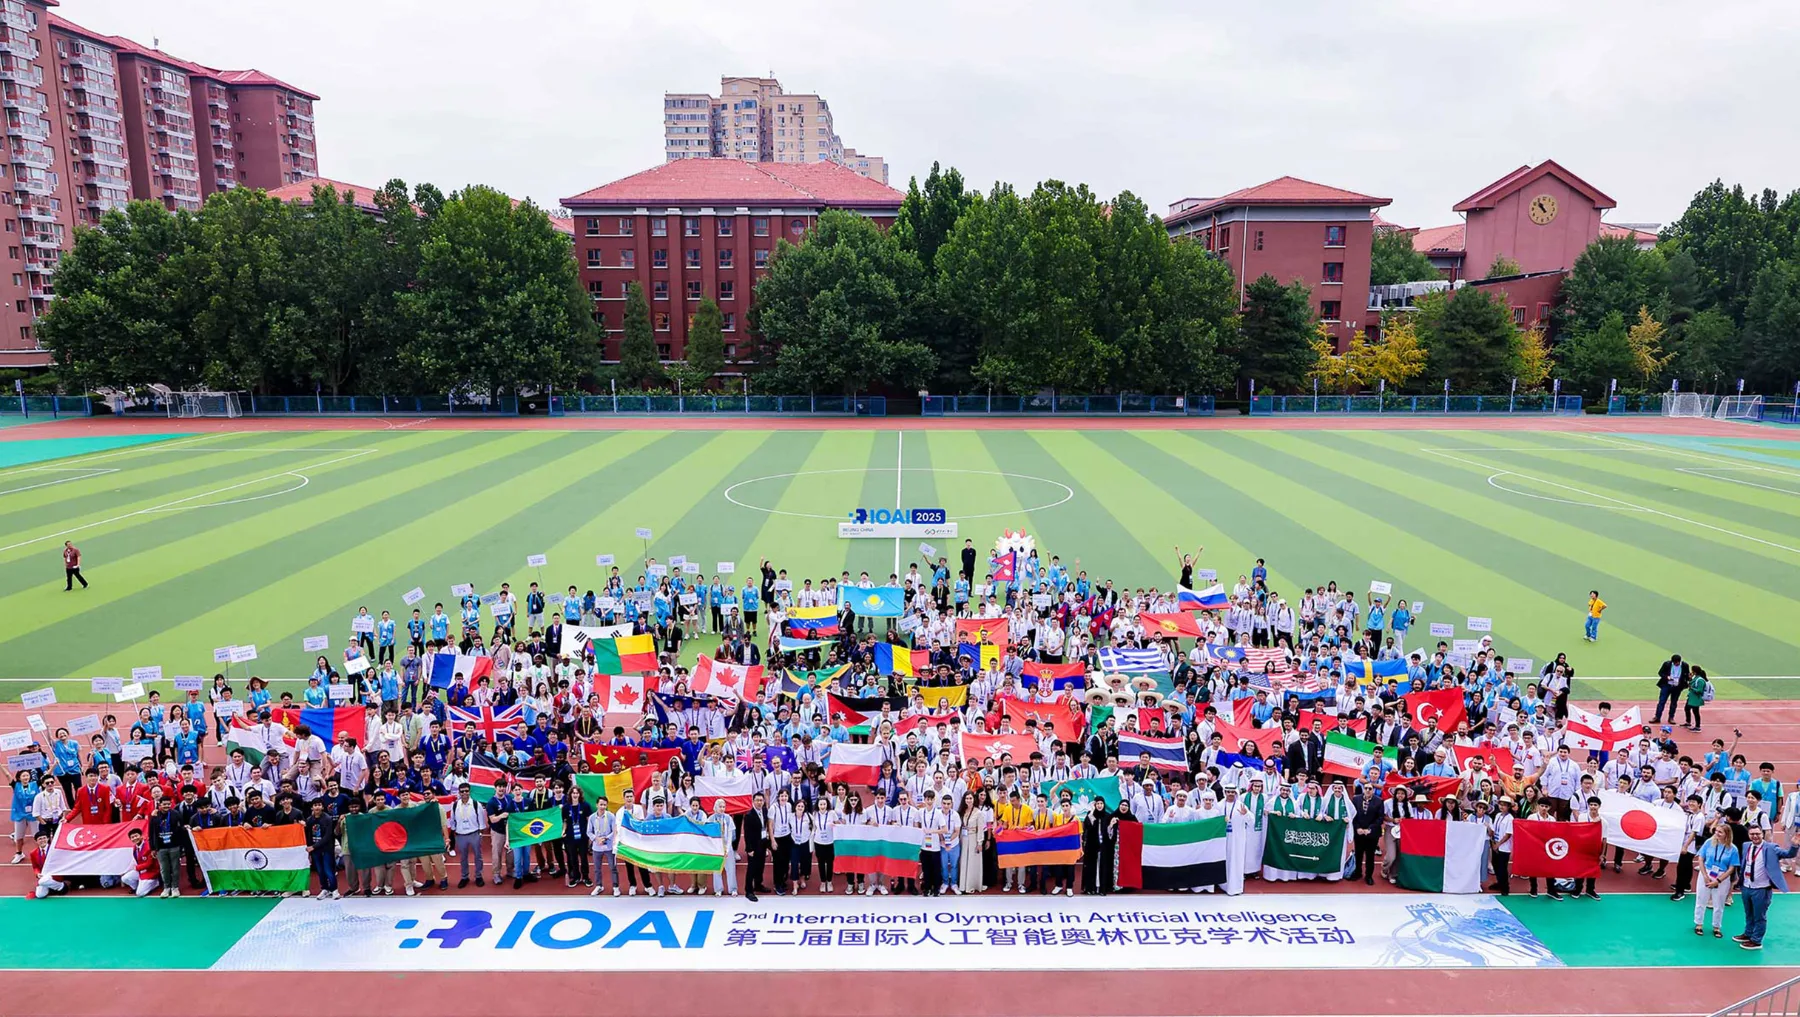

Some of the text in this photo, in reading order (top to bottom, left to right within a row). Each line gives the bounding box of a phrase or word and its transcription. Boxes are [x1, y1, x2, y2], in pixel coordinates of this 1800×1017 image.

[869, 509, 942, 524] IOAI 2025
[732, 911, 1337, 926] 2nd International Olympiad in Artificial Intelligence
[496, 910, 714, 949] IOAI
[723, 927, 1356, 947] 第二届国际人工智能奥林匹克学术活动
